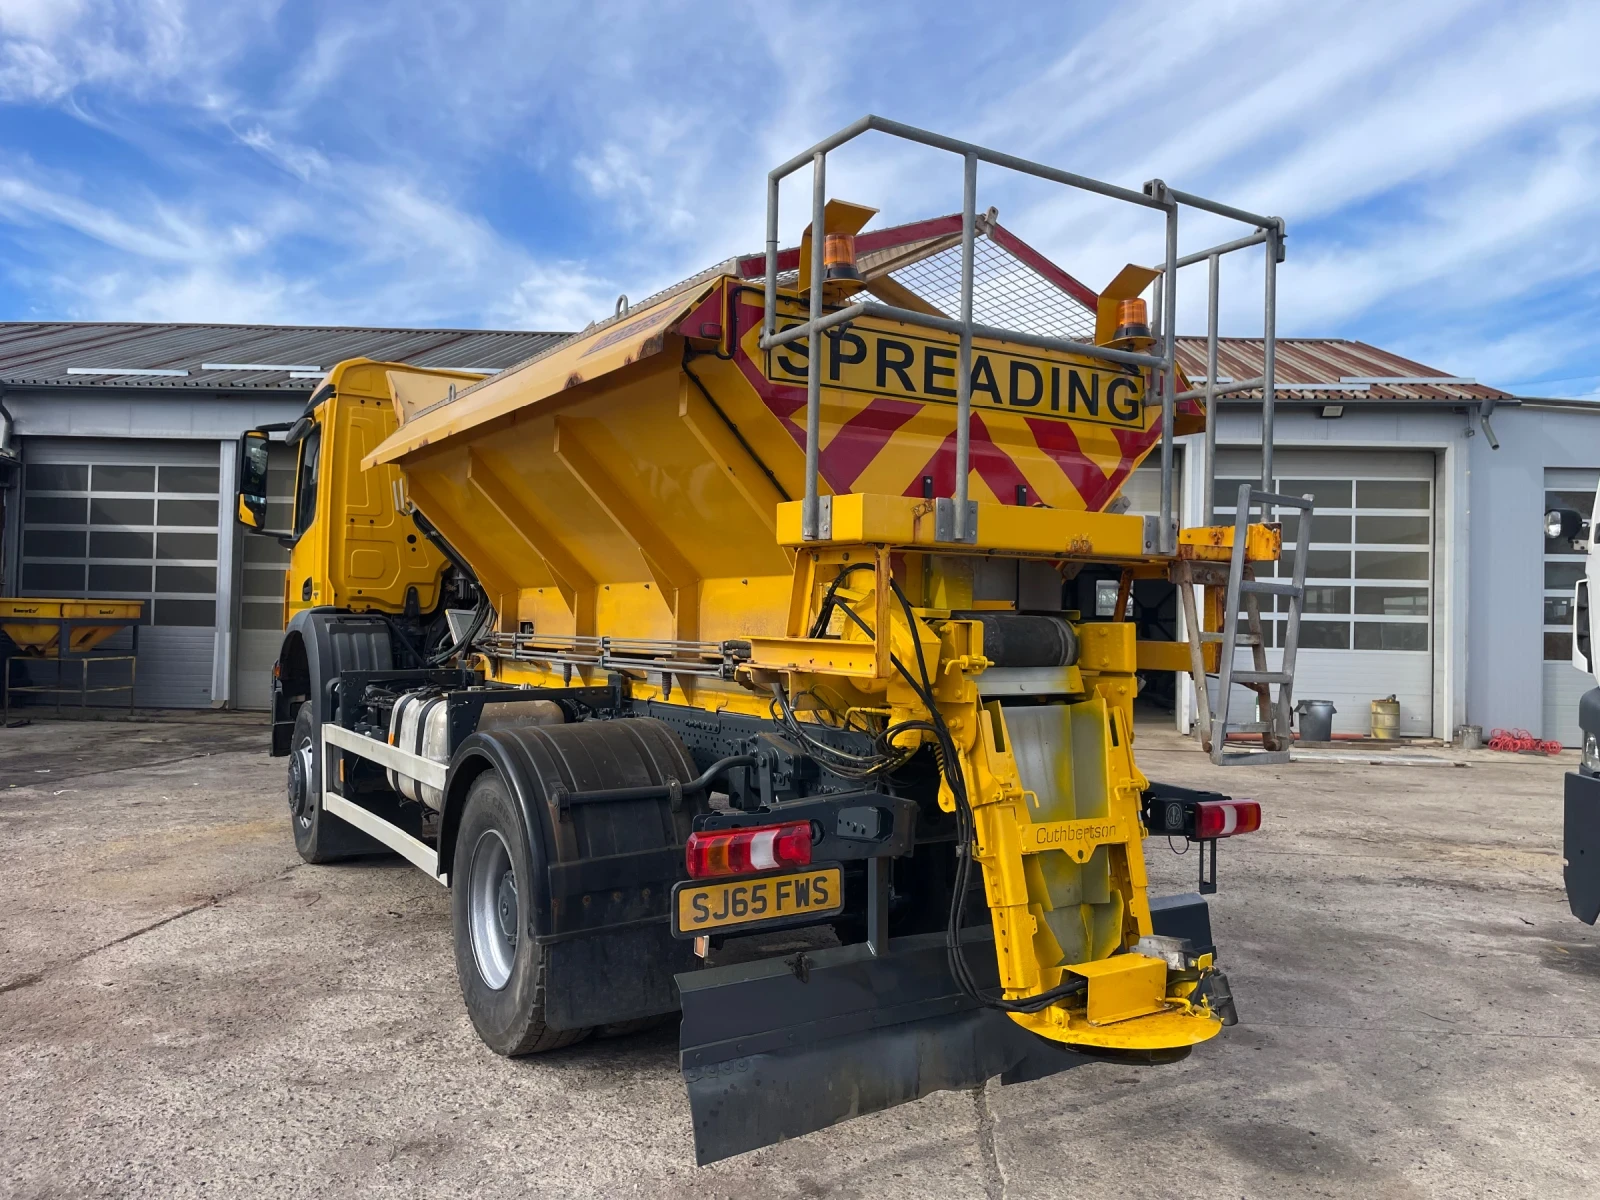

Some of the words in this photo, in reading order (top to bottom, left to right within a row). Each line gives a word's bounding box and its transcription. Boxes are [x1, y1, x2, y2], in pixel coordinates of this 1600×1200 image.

[777, 323, 1140, 421] SPREADING
[1036, 825, 1116, 844] Cuthbertson
[692, 883, 768, 924] SJ65
[776, 876, 829, 911] FWS
